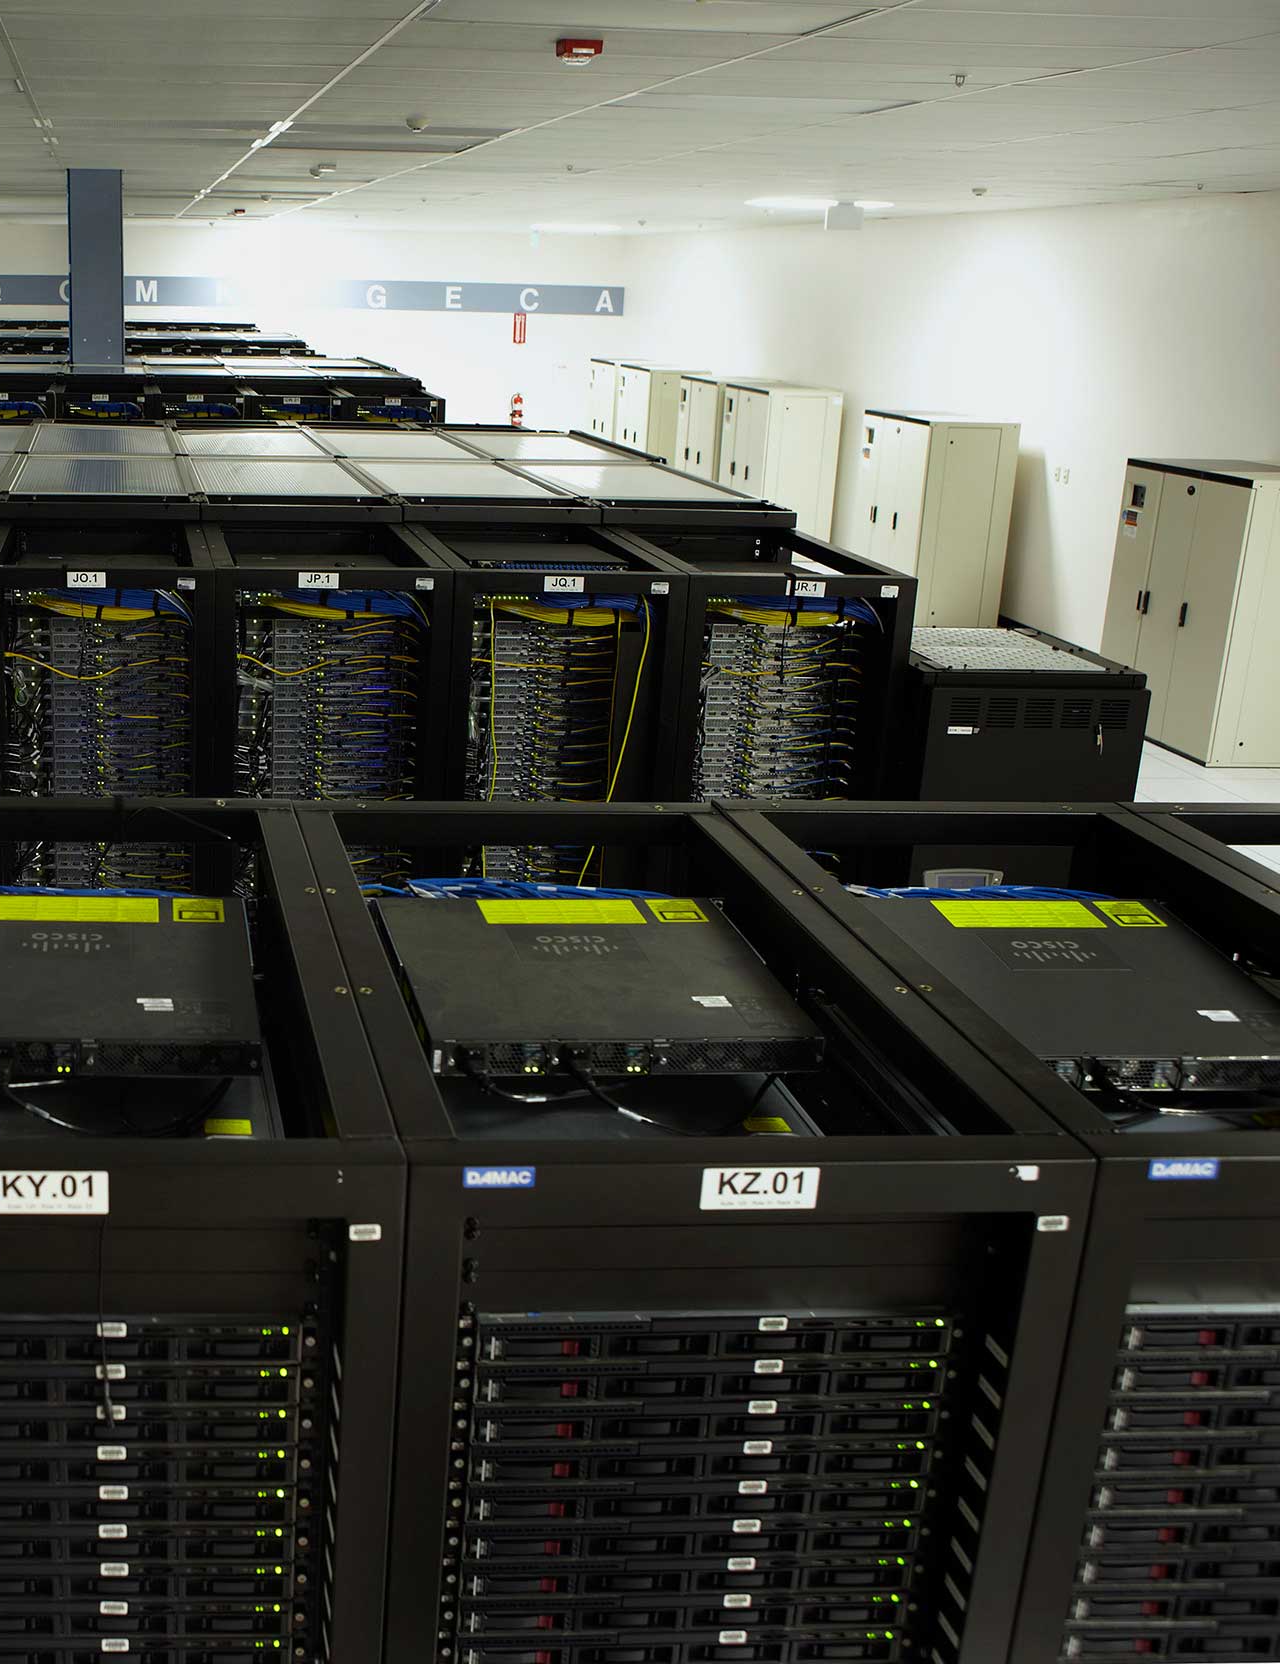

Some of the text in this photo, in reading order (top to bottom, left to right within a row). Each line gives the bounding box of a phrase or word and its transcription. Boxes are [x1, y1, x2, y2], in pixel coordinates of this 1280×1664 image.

[135, 280, 158, 302] M
[366, 284, 614, 312] G E C A
[73, 573, 98, 583] JO.1
[306, 573, 330, 584] JP.1
[551, 577, 576, 588] JQ.1
[32, 932, 103, 941] CISCO
[1010, 941, 1079, 949] CISCO
[1151, 1162, 1216, 1177] DAMAC
[466, 1170, 532, 1185] DAMAC
[718, 1171, 804, 1195] KZ.01
[2, 1175, 93, 1198] KY.01
